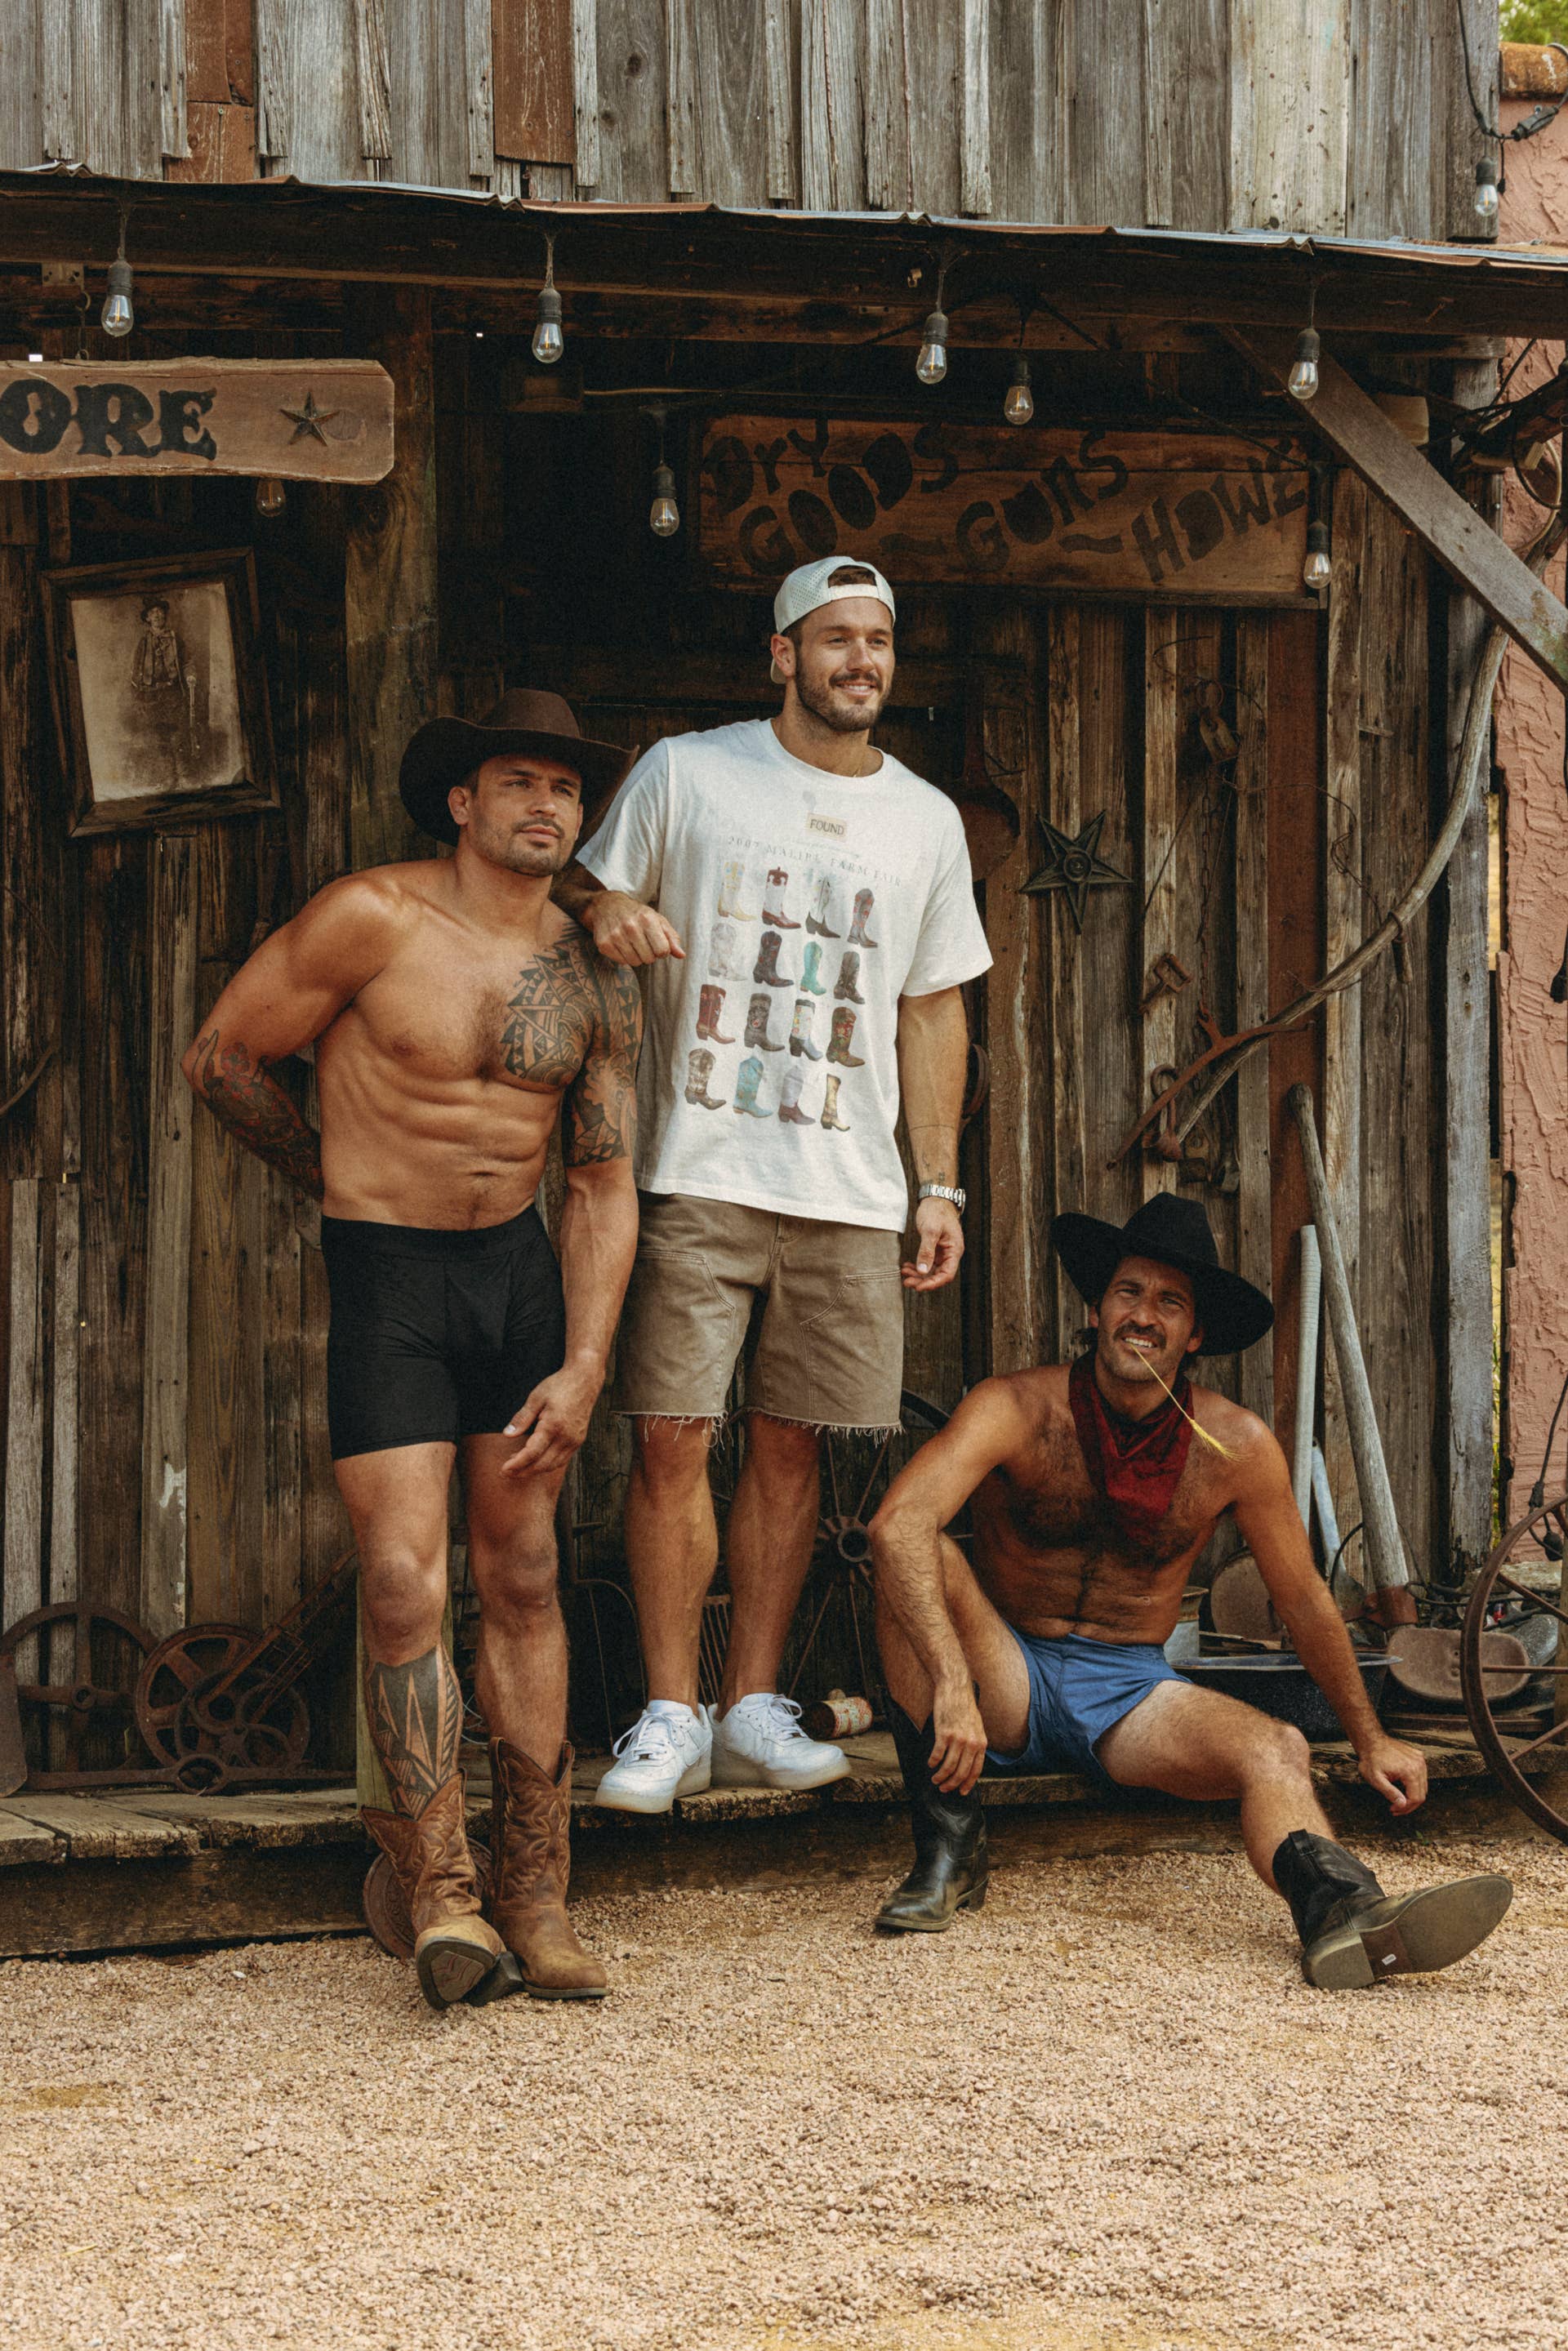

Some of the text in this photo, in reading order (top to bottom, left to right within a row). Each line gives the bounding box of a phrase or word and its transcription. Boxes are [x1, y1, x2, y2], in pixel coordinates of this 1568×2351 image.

[0, 379, 217, 461] ORE
[739, 421, 959, 576] GOODS
[809, 818, 845, 836] FOUND
[830, 857, 871, 876] FARM
